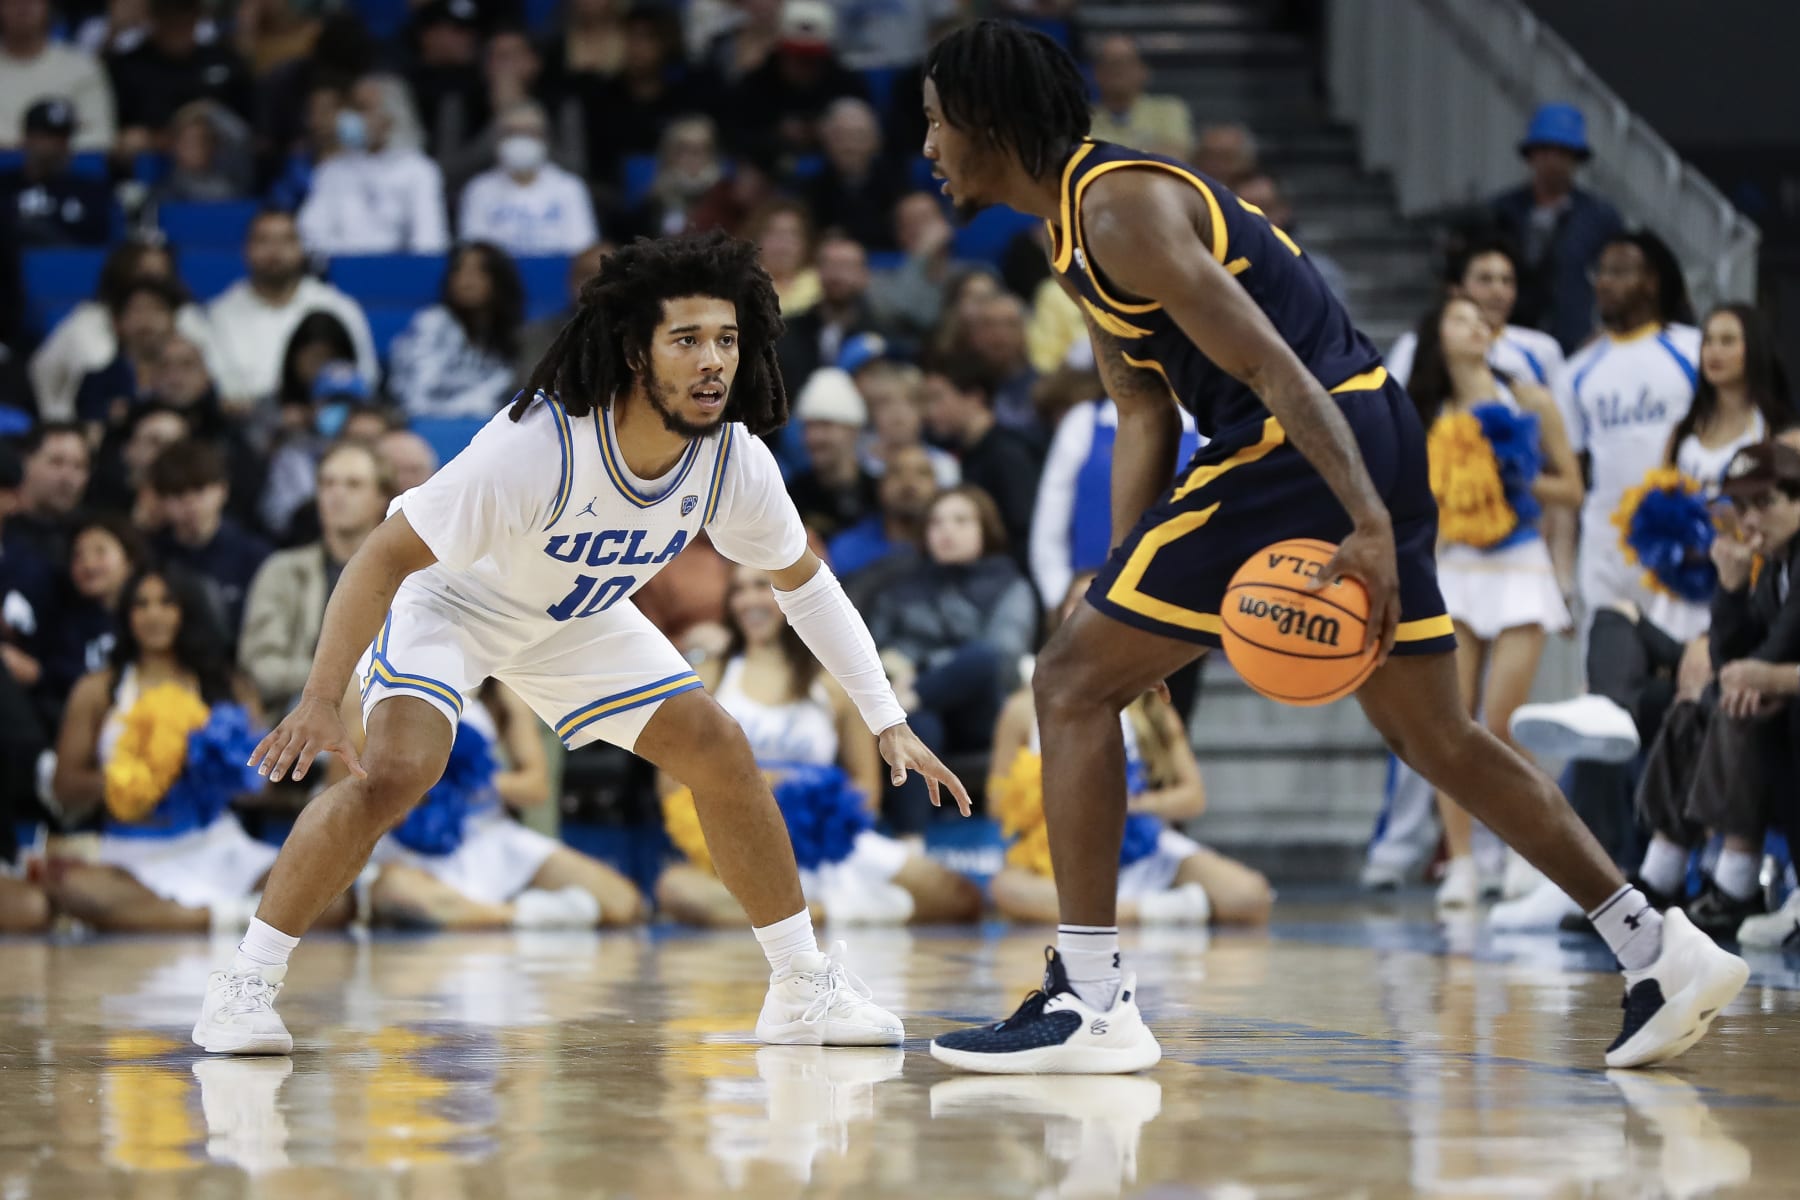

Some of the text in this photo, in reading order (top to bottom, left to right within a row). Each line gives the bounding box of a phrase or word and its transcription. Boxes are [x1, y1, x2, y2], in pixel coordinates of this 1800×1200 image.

[543, 529, 688, 567] UCLA
[1268, 552, 1344, 586] CLA
[546, 574, 636, 621] 10
[1239, 595, 1341, 647] Wilson
